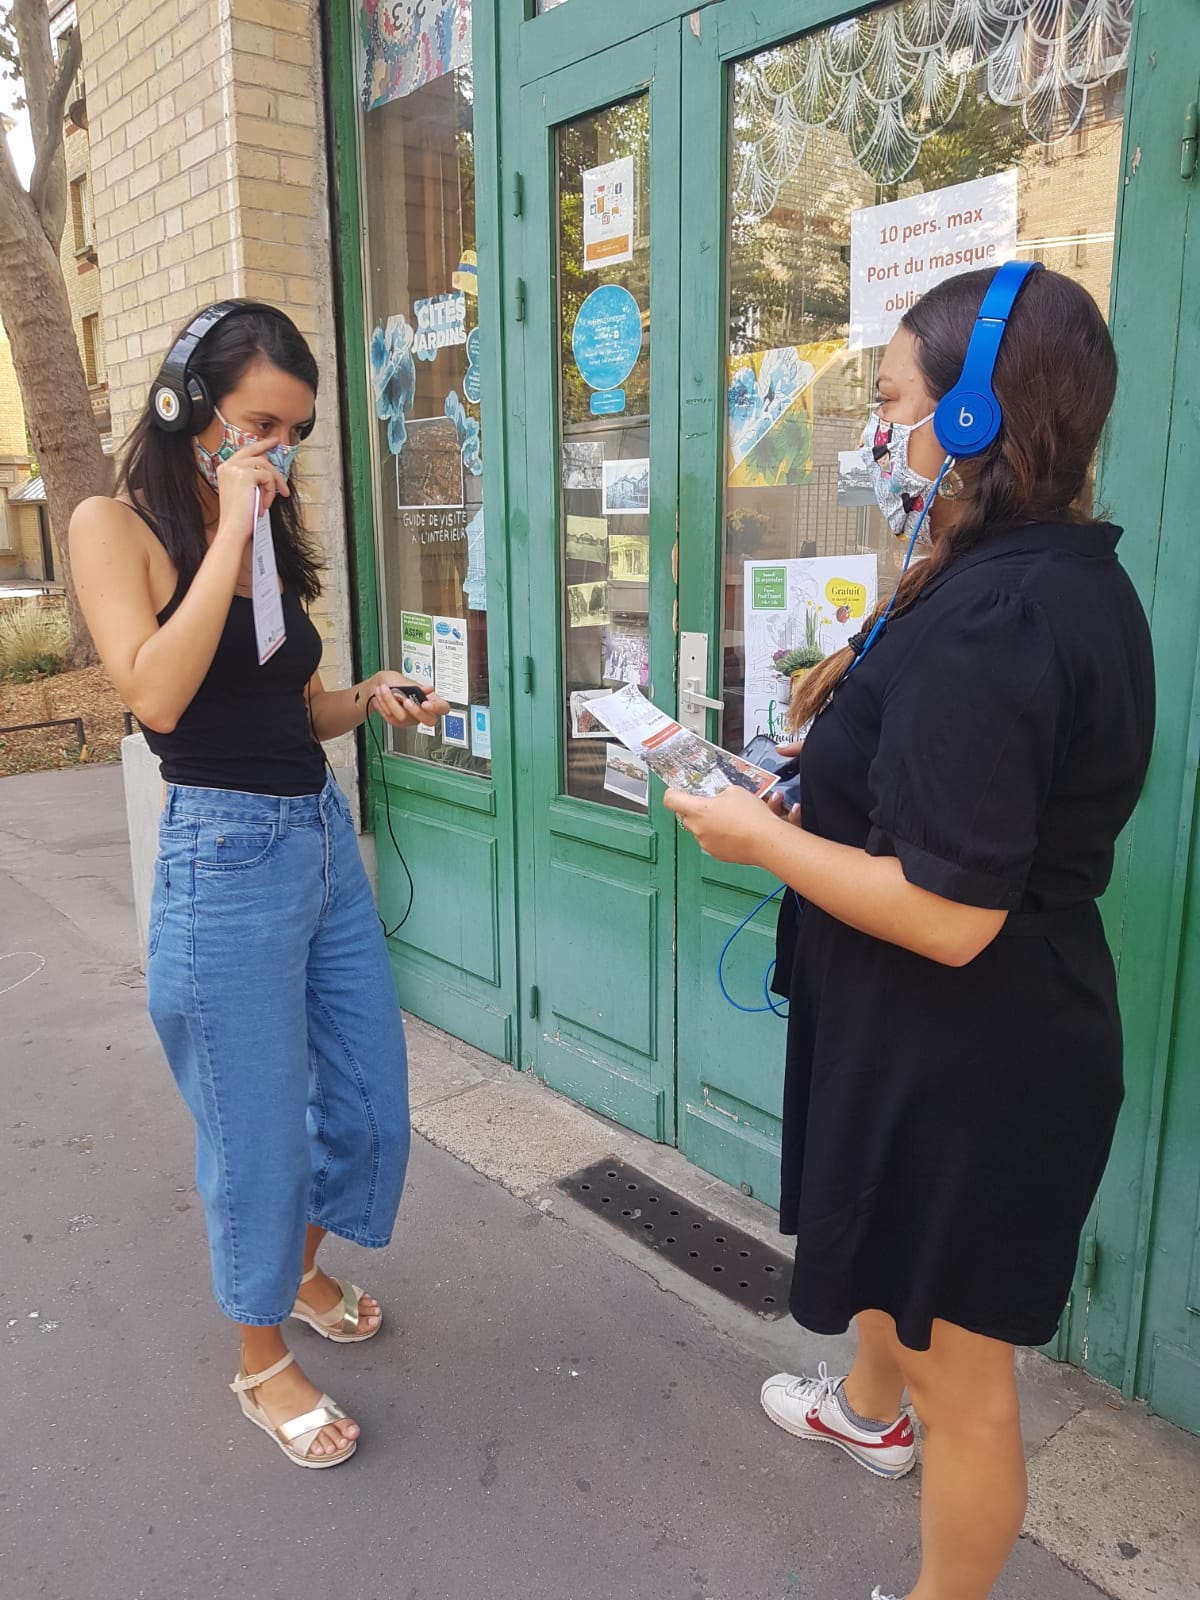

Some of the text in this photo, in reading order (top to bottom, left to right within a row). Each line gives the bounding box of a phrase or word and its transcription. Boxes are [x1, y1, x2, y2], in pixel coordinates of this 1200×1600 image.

[880, 207, 983, 244] 10 pers. max
[867, 243, 996, 283] Port du masque
[412, 325, 467, 354] JARDINS
[402, 510, 467, 528] GUIDE DE VISITE
